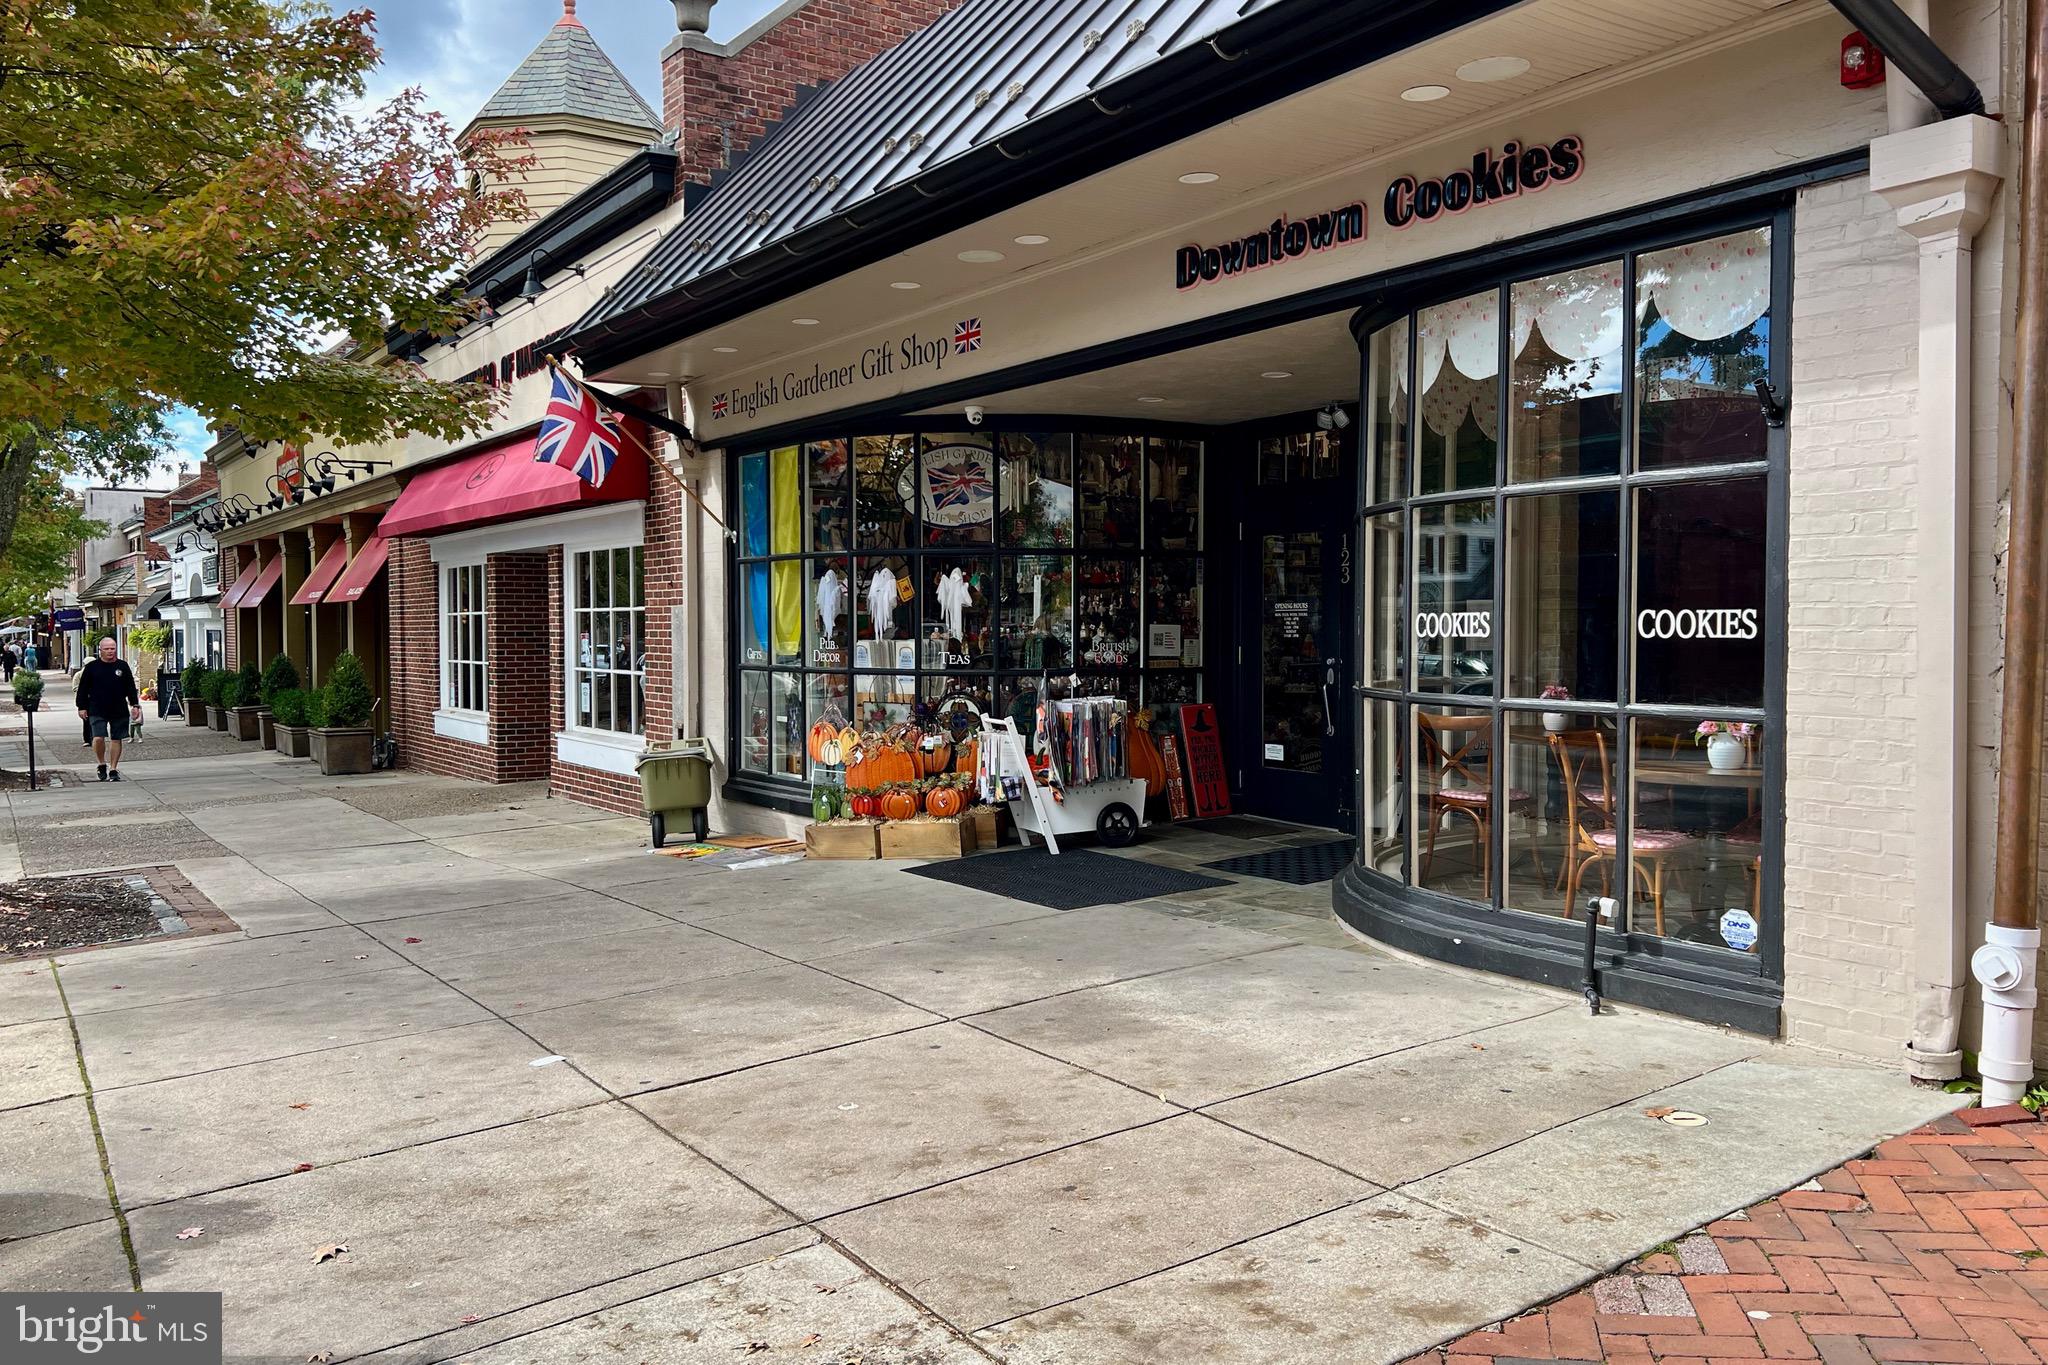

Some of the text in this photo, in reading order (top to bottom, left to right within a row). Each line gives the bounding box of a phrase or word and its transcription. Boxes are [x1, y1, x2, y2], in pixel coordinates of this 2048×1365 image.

[1176, 134, 1584, 292] Downtown Cookies
[732, 332, 949, 418] English Gardener Gift Shop
[1415, 611, 1491, 638] COOKIES
[1638, 608, 1758, 640] COOKIES
[819, 637, 835, 650] PUB
[1092, 641, 1130, 652] BRITISH
[813, 650, 840, 662] DECOR
[938, 651, 971, 665] TEAS
[1727, 920, 1751, 930] DNS
